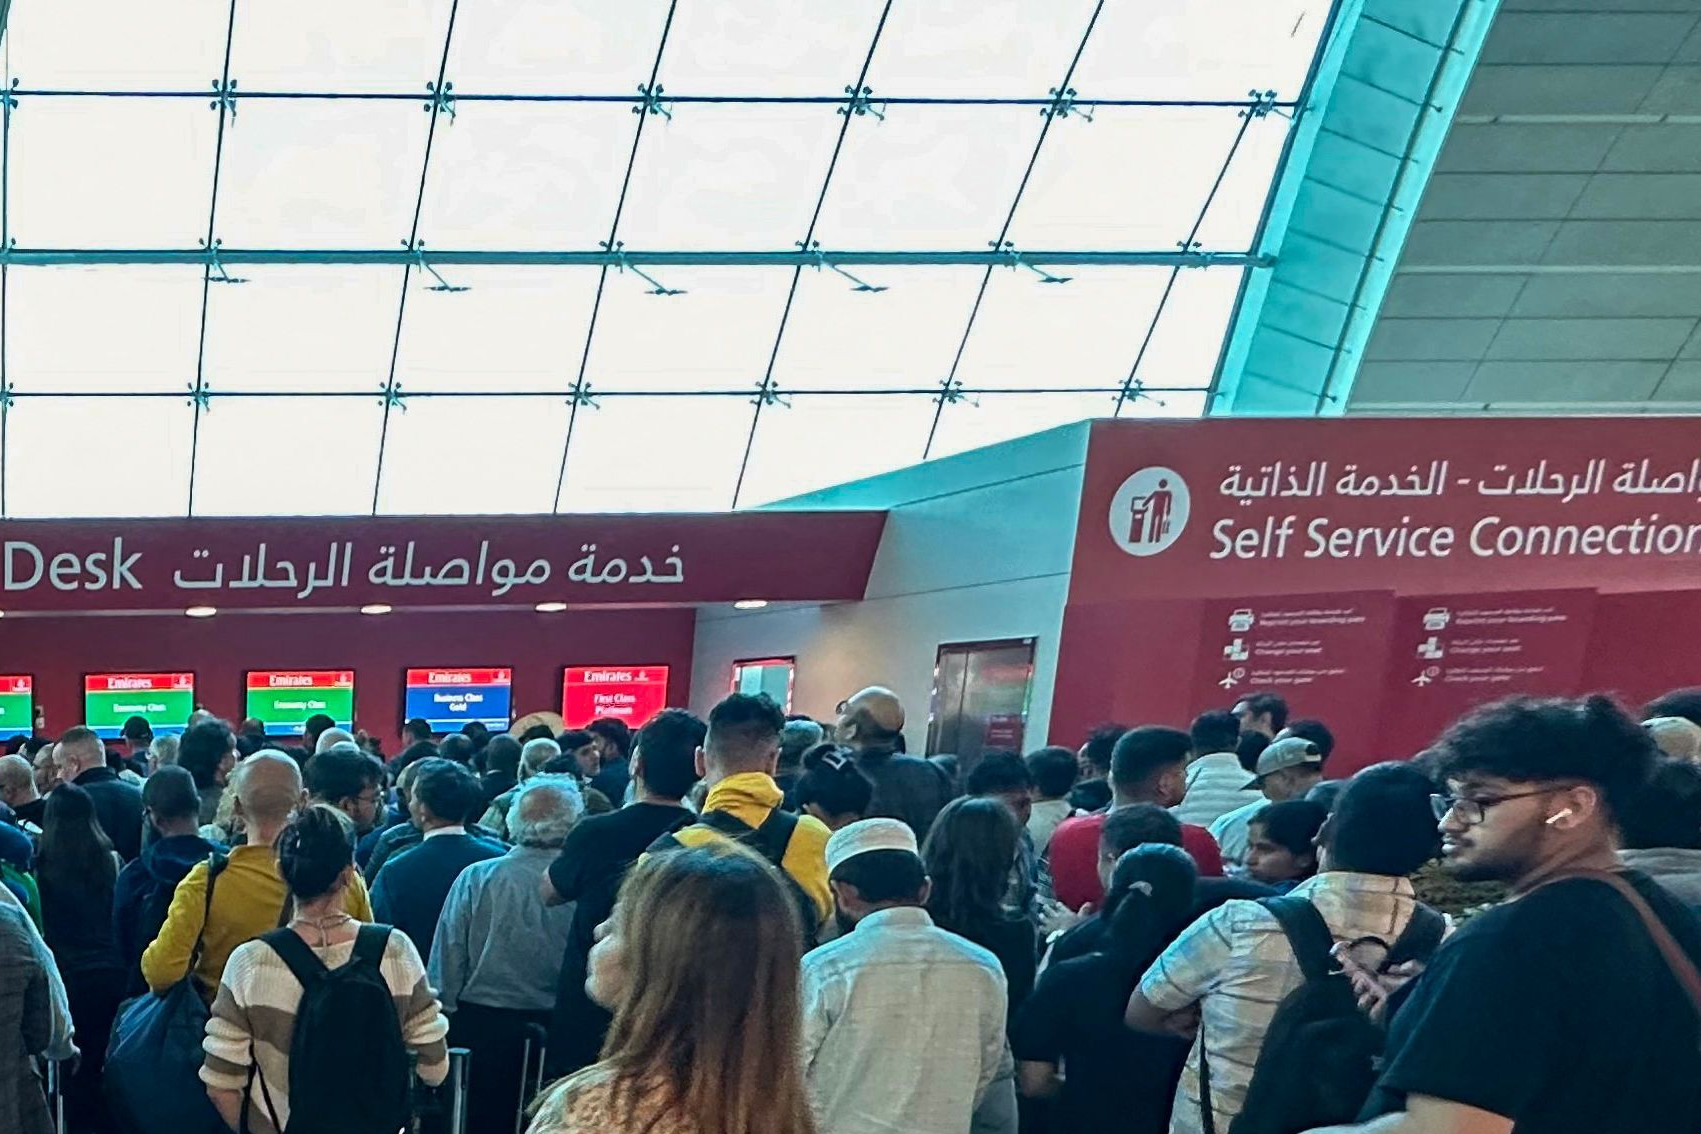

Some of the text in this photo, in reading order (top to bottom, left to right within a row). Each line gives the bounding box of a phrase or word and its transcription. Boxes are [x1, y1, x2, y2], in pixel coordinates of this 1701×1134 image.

[1219, 461, 1328, 507] الذاتية
[1335, 460, 1449, 497] الخدمة
[1477, 459, 1606, 503] الرحلات
[1612, 458, 1701, 504] اصلة
[1209, 515, 1297, 560] Self
[1304, 515, 1455, 559] Service
[3, 537, 144, 592] Desk
[173, 541, 686, 599] خدمة مواصلة الرحلات
[107, 677, 153, 689] Emirates
[269, 675, 313, 686] Emirates
[428, 672, 472, 683] Emirates
[584, 671, 632, 682] Emirates
